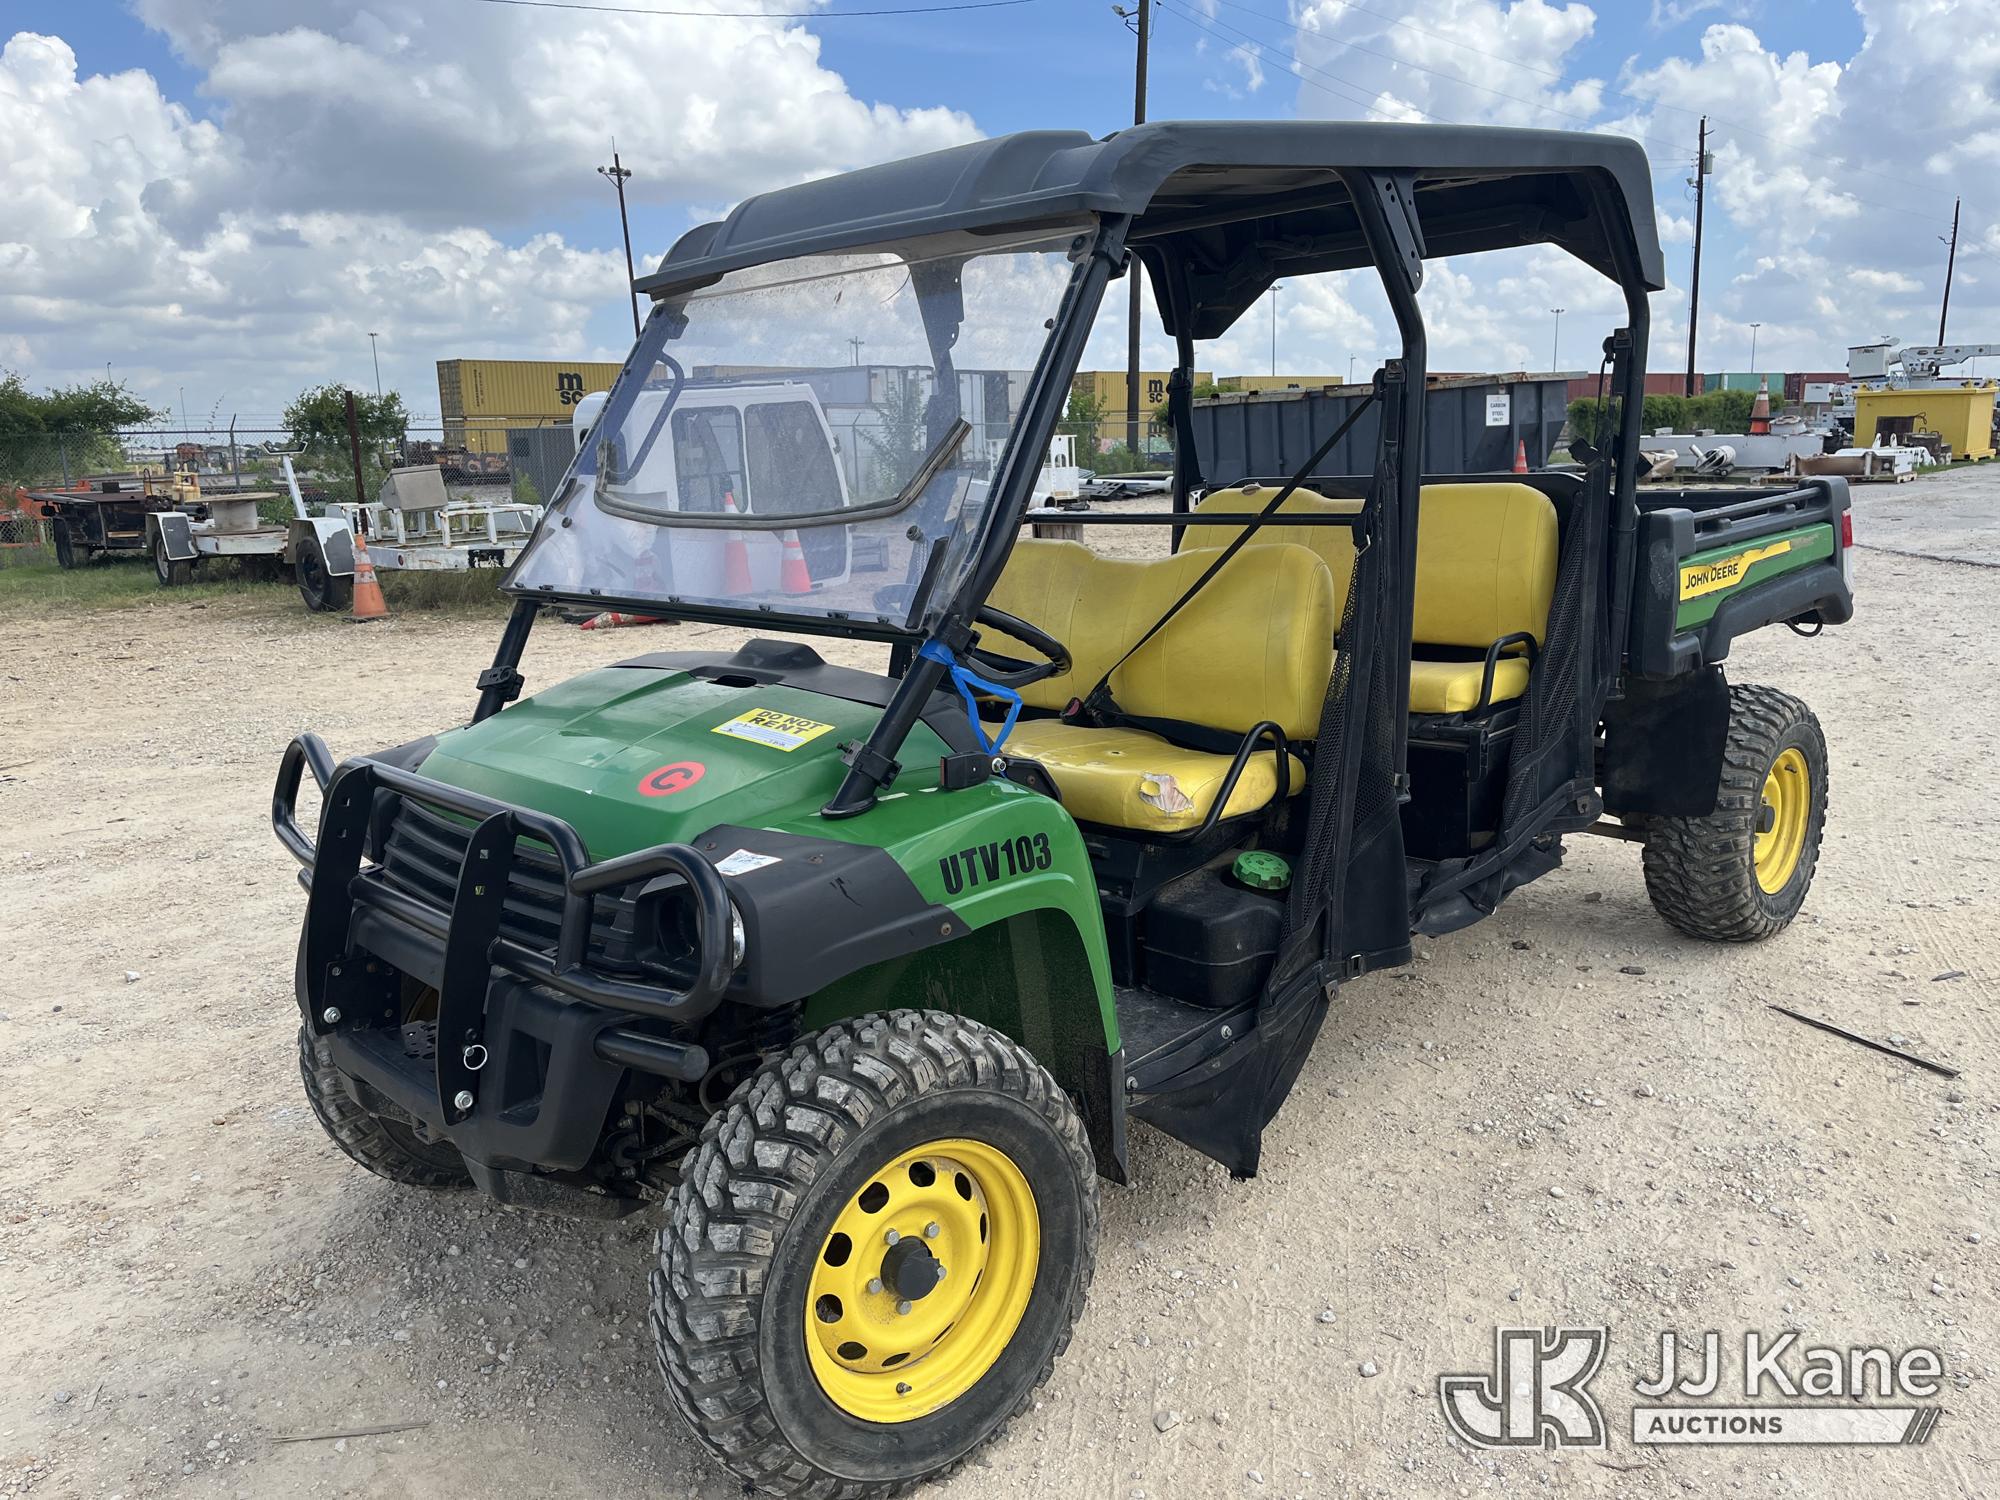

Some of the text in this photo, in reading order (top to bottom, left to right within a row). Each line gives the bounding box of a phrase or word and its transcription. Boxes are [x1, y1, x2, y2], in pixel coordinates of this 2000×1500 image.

[1686, 563, 1738, 589] JOHN DEERE
[749, 717, 809, 734] RENT
[757, 710, 823, 729] DO NOT
[651, 767, 692, 790] C
[939, 832, 1052, 895] UTV103
